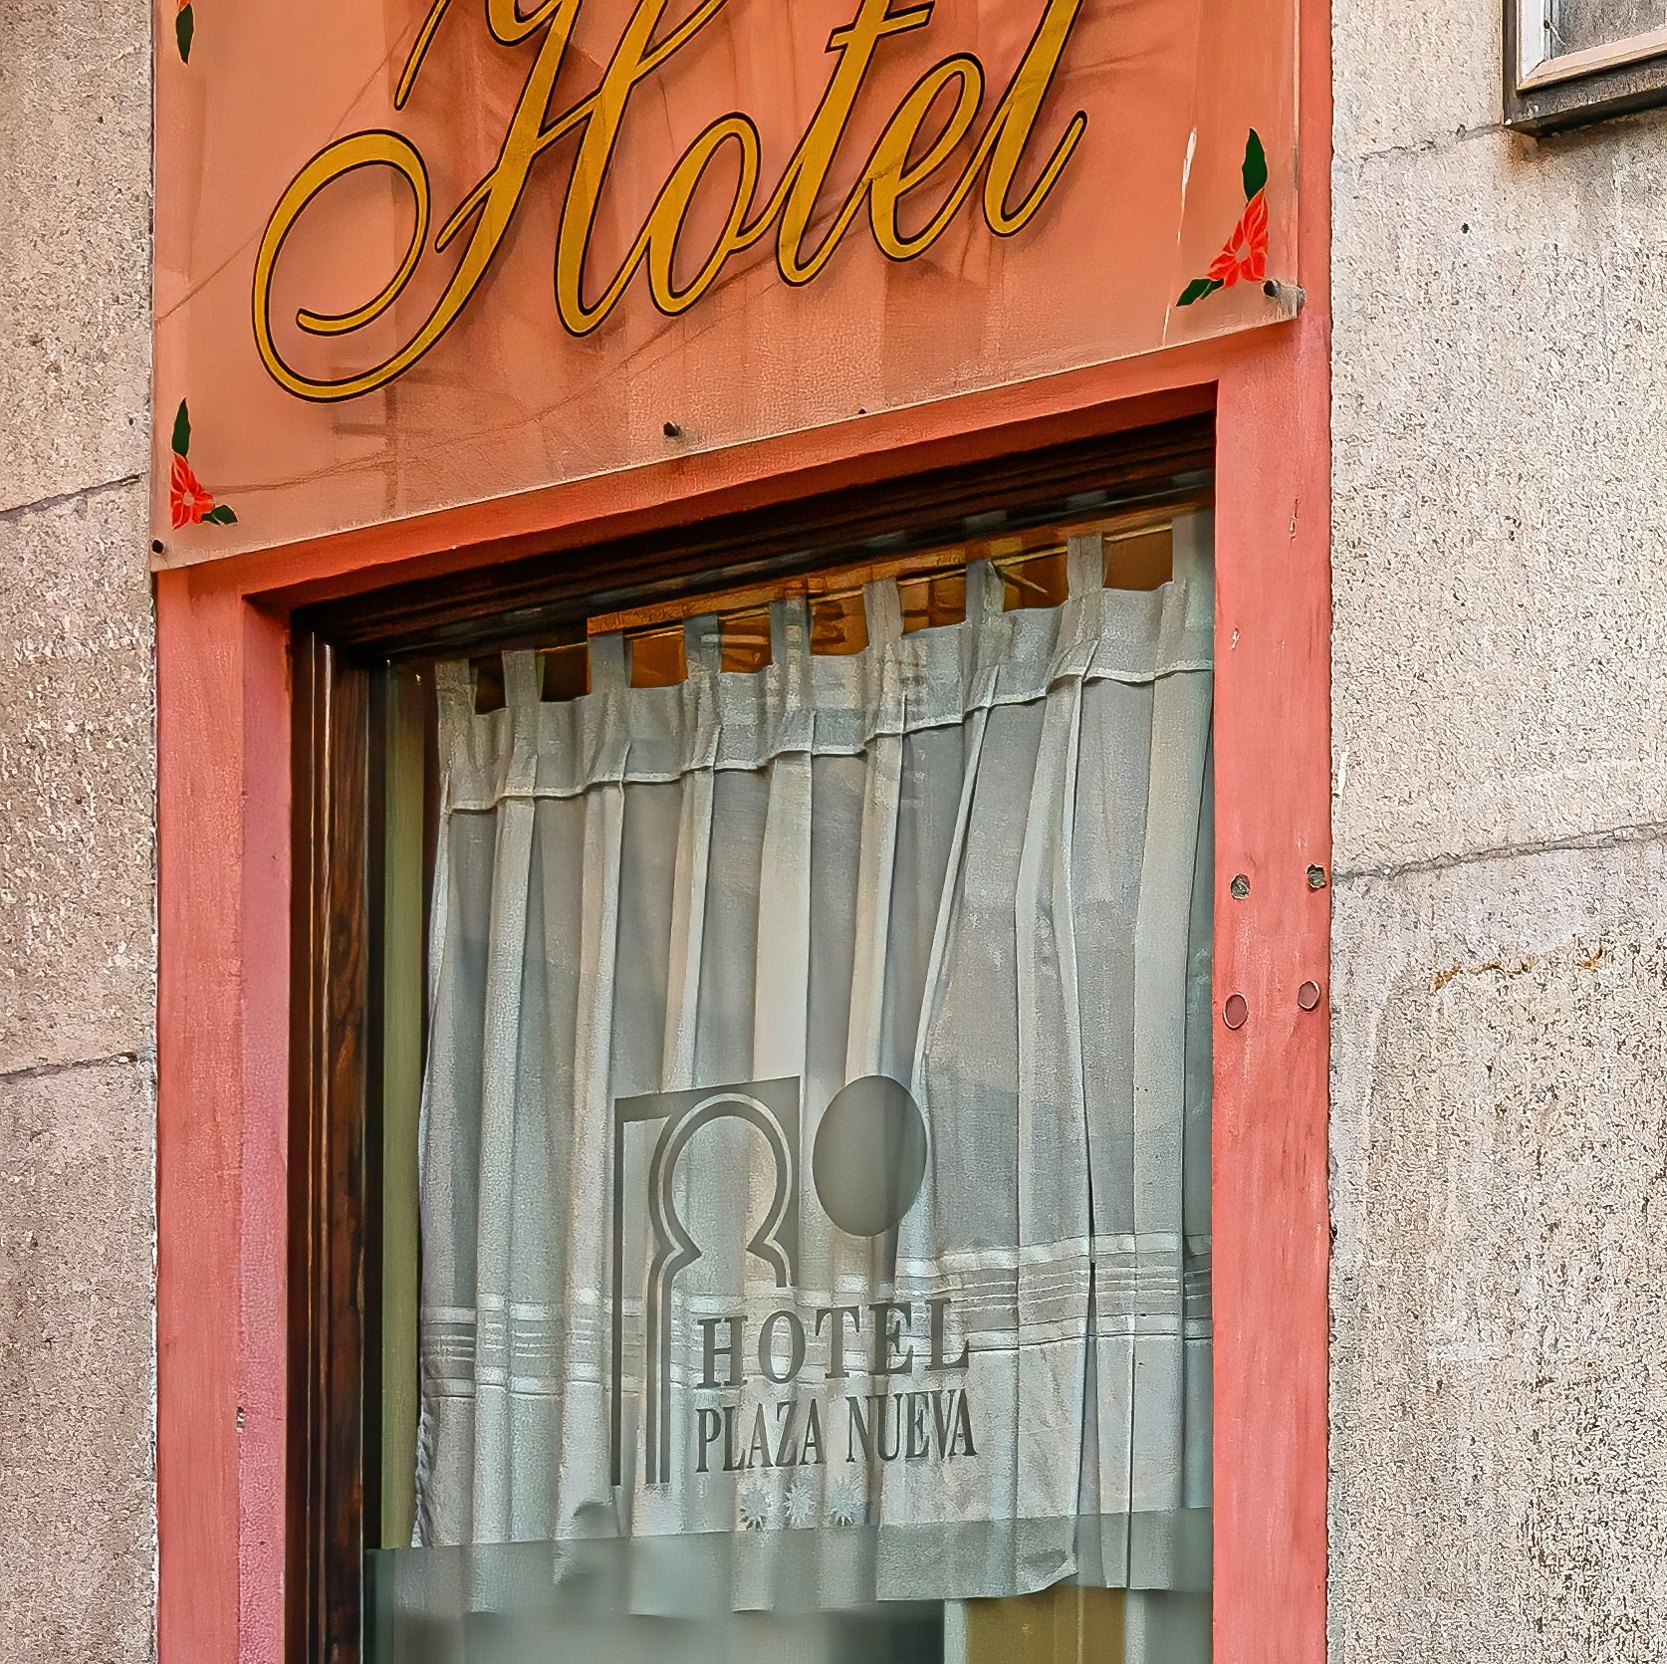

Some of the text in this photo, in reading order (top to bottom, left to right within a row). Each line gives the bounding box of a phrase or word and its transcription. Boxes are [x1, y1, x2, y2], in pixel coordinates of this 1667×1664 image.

[251, 0, 1088, 404] Hotel
[697, 1297, 970, 1390] HOTEL
[695, 1387, 979, 1474] PLAZA NUEVA
